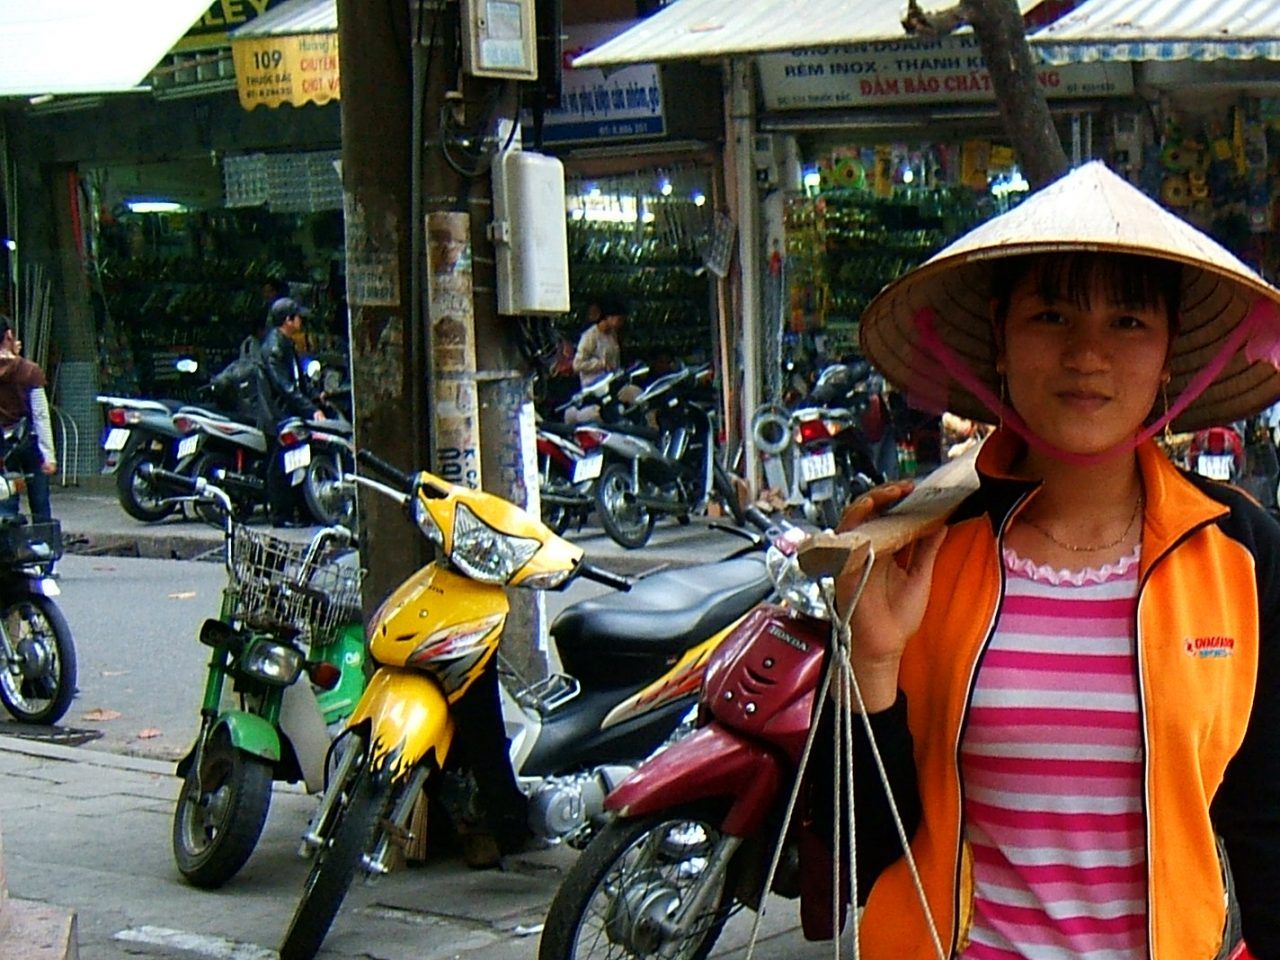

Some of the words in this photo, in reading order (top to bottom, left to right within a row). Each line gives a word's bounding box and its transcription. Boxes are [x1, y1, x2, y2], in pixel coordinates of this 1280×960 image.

[193, 0, 271, 28] LEY
[252, 49, 282, 70] 109
[829, 61, 877, 76] INOX
[767, 624, 811, 653] HONDA
